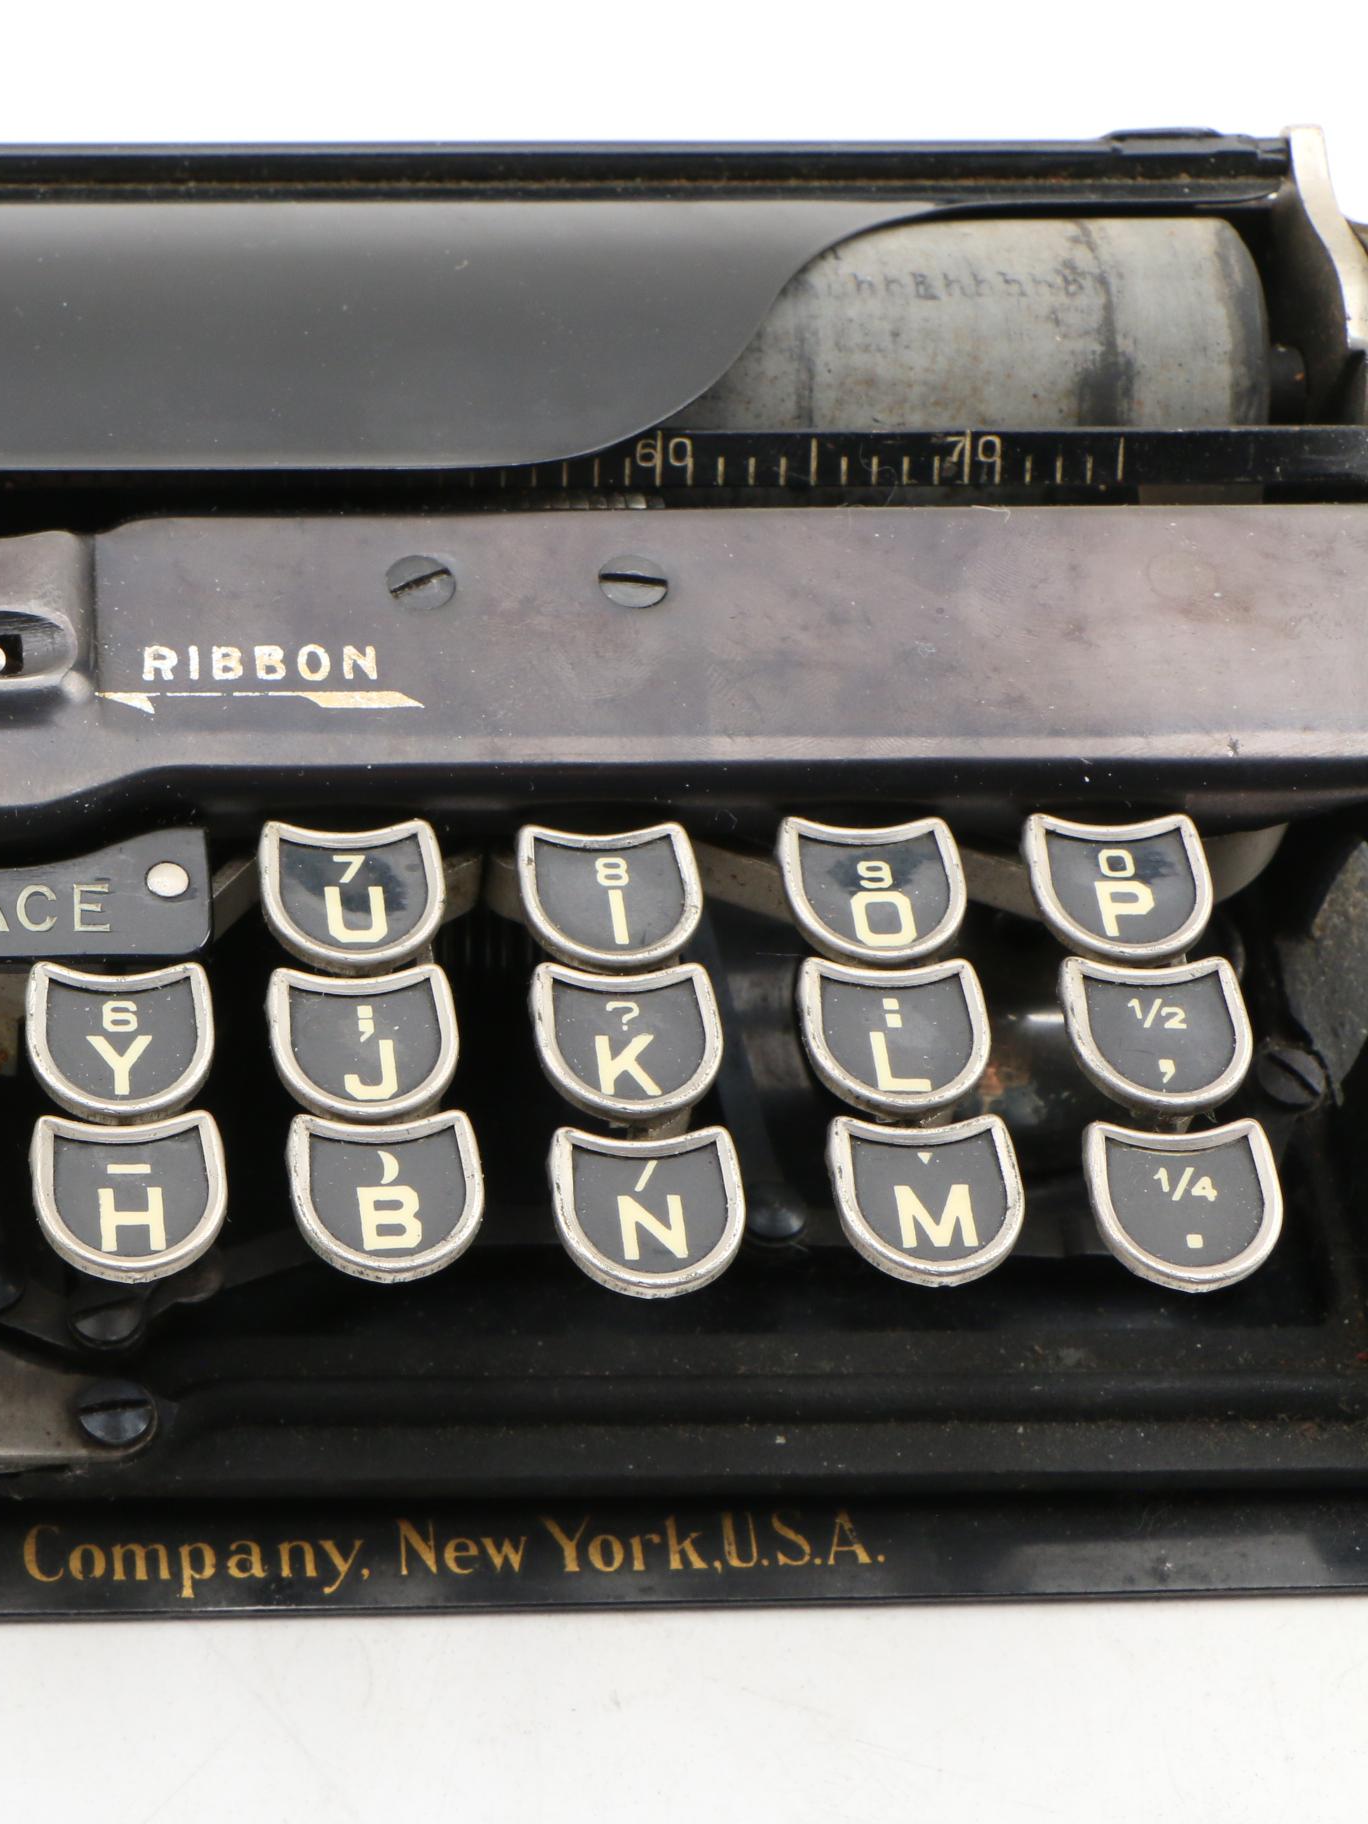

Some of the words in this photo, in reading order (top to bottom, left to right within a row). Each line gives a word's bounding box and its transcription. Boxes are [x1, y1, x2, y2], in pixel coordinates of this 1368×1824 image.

[142, 643, 378, 681] RIBBON
[332, 854, 366, 884] 7
[594, 857, 630, 887] 8
[856, 860, 893, 889] 9
[1097, 848, 1136, 878] 0
[325, 886, 388, 940] U
[610, 889, 630, 943] I
[853, 890, 918, 947] O
[1097, 880, 1155, 935] P
[102, 1000, 138, 1033] 6
[605, 1000, 640, 1032] ?
[88, 1035, 151, 1092] Y
[344, 1039, 398, 1098] J
[597, 1034, 662, 1094] K
[873, 1032, 933, 1090] L
[99, 1187, 165, 1249] H
[359, 1185, 423, 1249] B
[619, 1195, 689, 1258] N
[897, 1184, 979, 1247] M
[24, 1523, 370, 1599] Company,
[398, 1518, 526, 1577] New
